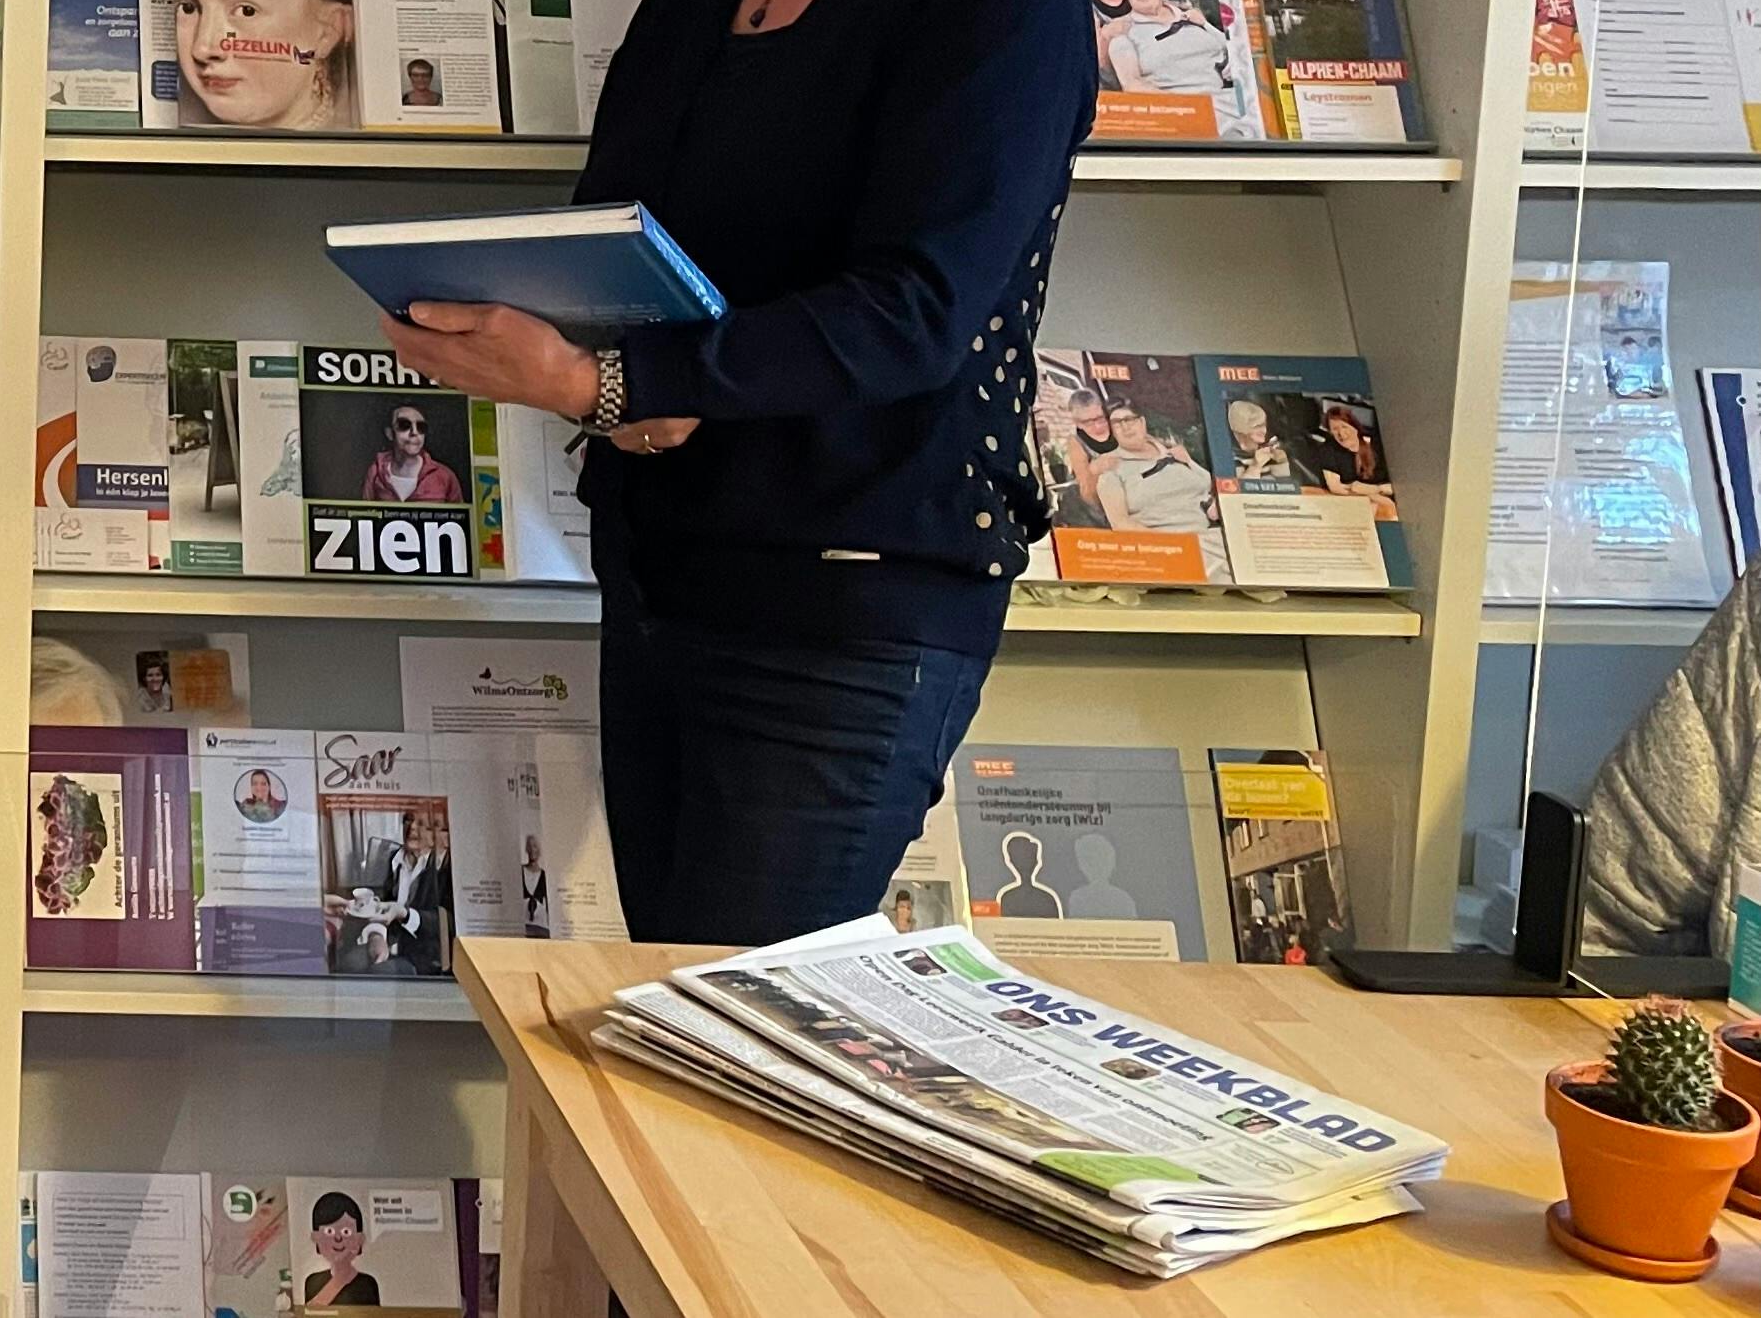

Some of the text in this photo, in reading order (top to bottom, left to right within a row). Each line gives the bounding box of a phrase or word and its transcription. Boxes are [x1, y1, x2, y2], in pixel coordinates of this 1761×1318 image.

[219, 37, 292, 56] GEZELLIN
[1290, 61, 1404, 80] ALPHEN-CHAAM
[1218, 366, 1260, 381] MEE
[314, 518, 469, 575] zien
[977, 784, 1063, 800] Onafhankelijke
[1095, 801, 1112, 815] bij
[1045, 814, 1071, 826] zorg
[985, 981, 1397, 1153] ONS WEEKBLAD
